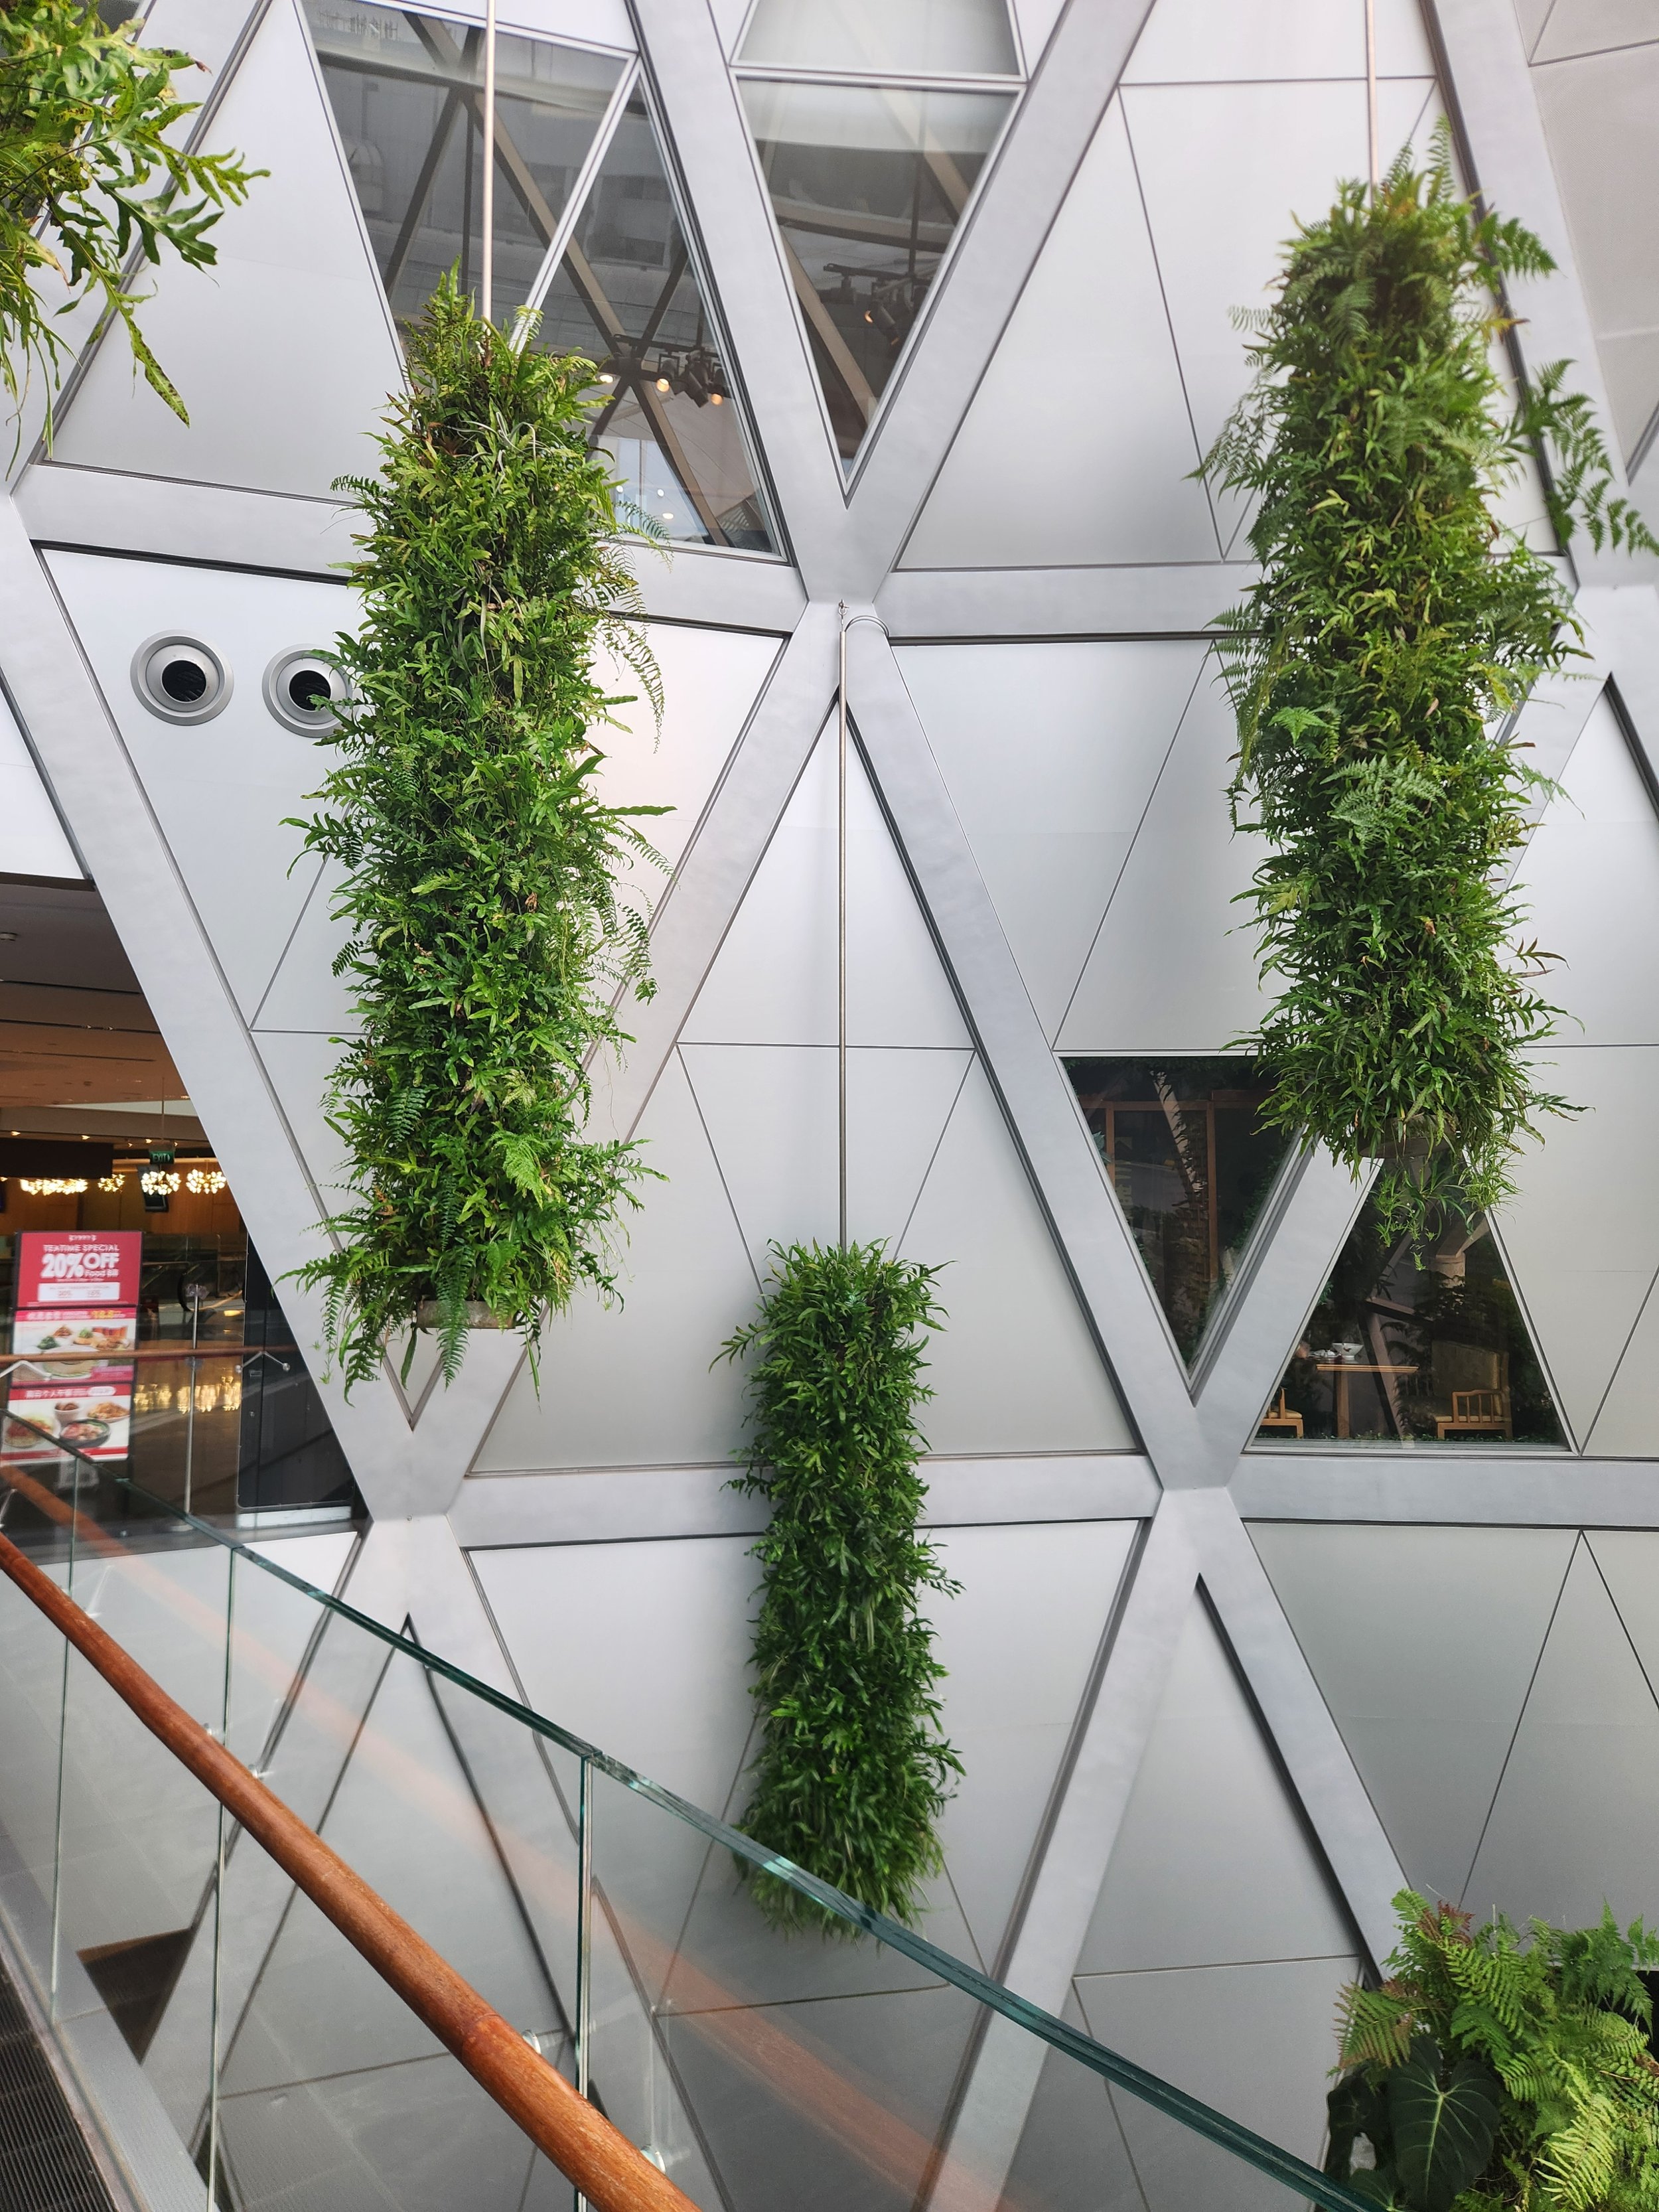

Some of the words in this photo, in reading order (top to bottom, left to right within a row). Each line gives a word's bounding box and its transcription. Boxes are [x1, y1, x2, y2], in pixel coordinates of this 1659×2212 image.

[153, 1153, 167, 1161] EXIT
[41, 1253, 85, 1278] 20%
[84, 1252, 119, 1269] OFF
